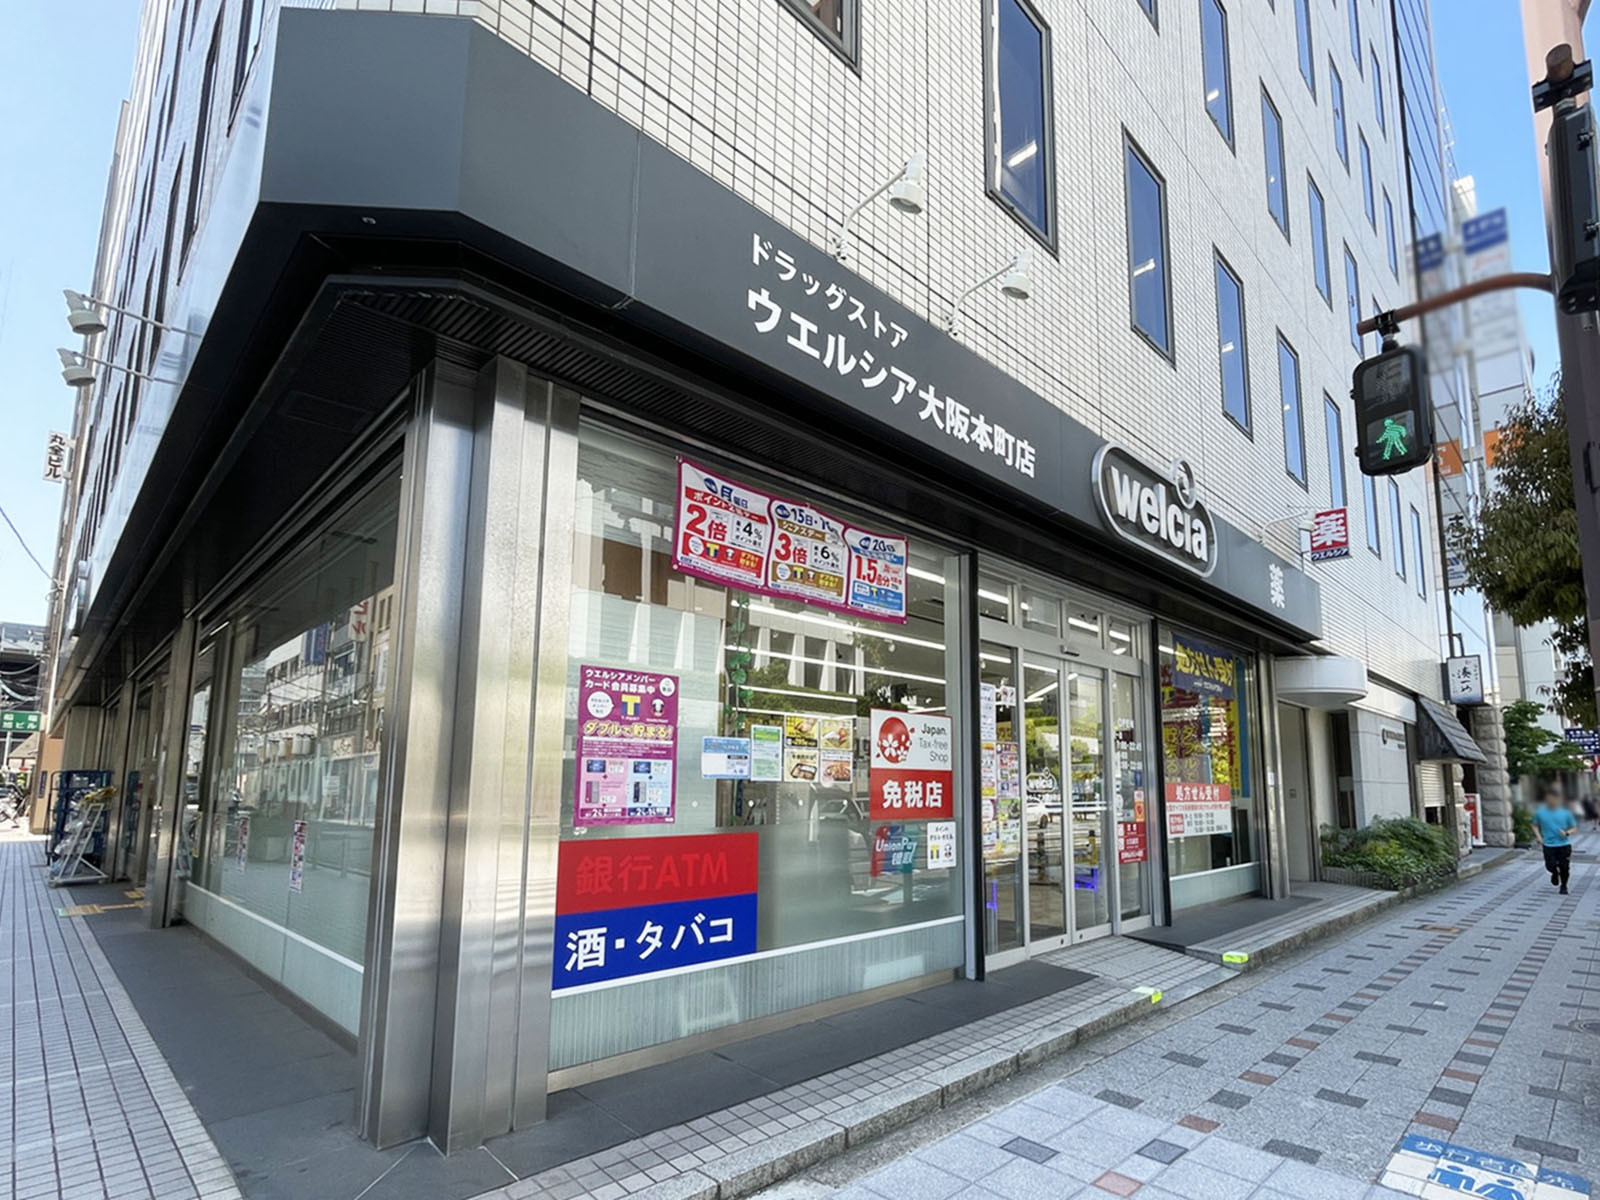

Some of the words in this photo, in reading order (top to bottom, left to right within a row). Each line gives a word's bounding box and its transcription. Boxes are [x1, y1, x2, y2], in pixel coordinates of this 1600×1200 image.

[753, 233, 909, 348] ドラッグストア
[747, 287, 1037, 478] ウエルシア大阪本町店
[686, 503, 728, 541] 2倍
[1105, 464, 1208, 562] welcia
[1311, 513, 1347, 548] 薬
[775, 533, 807, 565] 3倍
[872, 539, 896, 553] 20日
[584, 679, 656, 695] カード会員募集中
[585, 669, 656, 683] ウエルシアメンバー
[583, 719, 674, 740] ダブルで貯まる!
[919, 738, 949, 750] Tax-free
[929, 752, 949, 764] Shop
[882, 780, 943, 809] 免税店
[875, 836, 917, 857] UnionPay
[575, 852, 729, 895] 銀行ATM
[564, 912, 733, 972] 酒・タバコ
